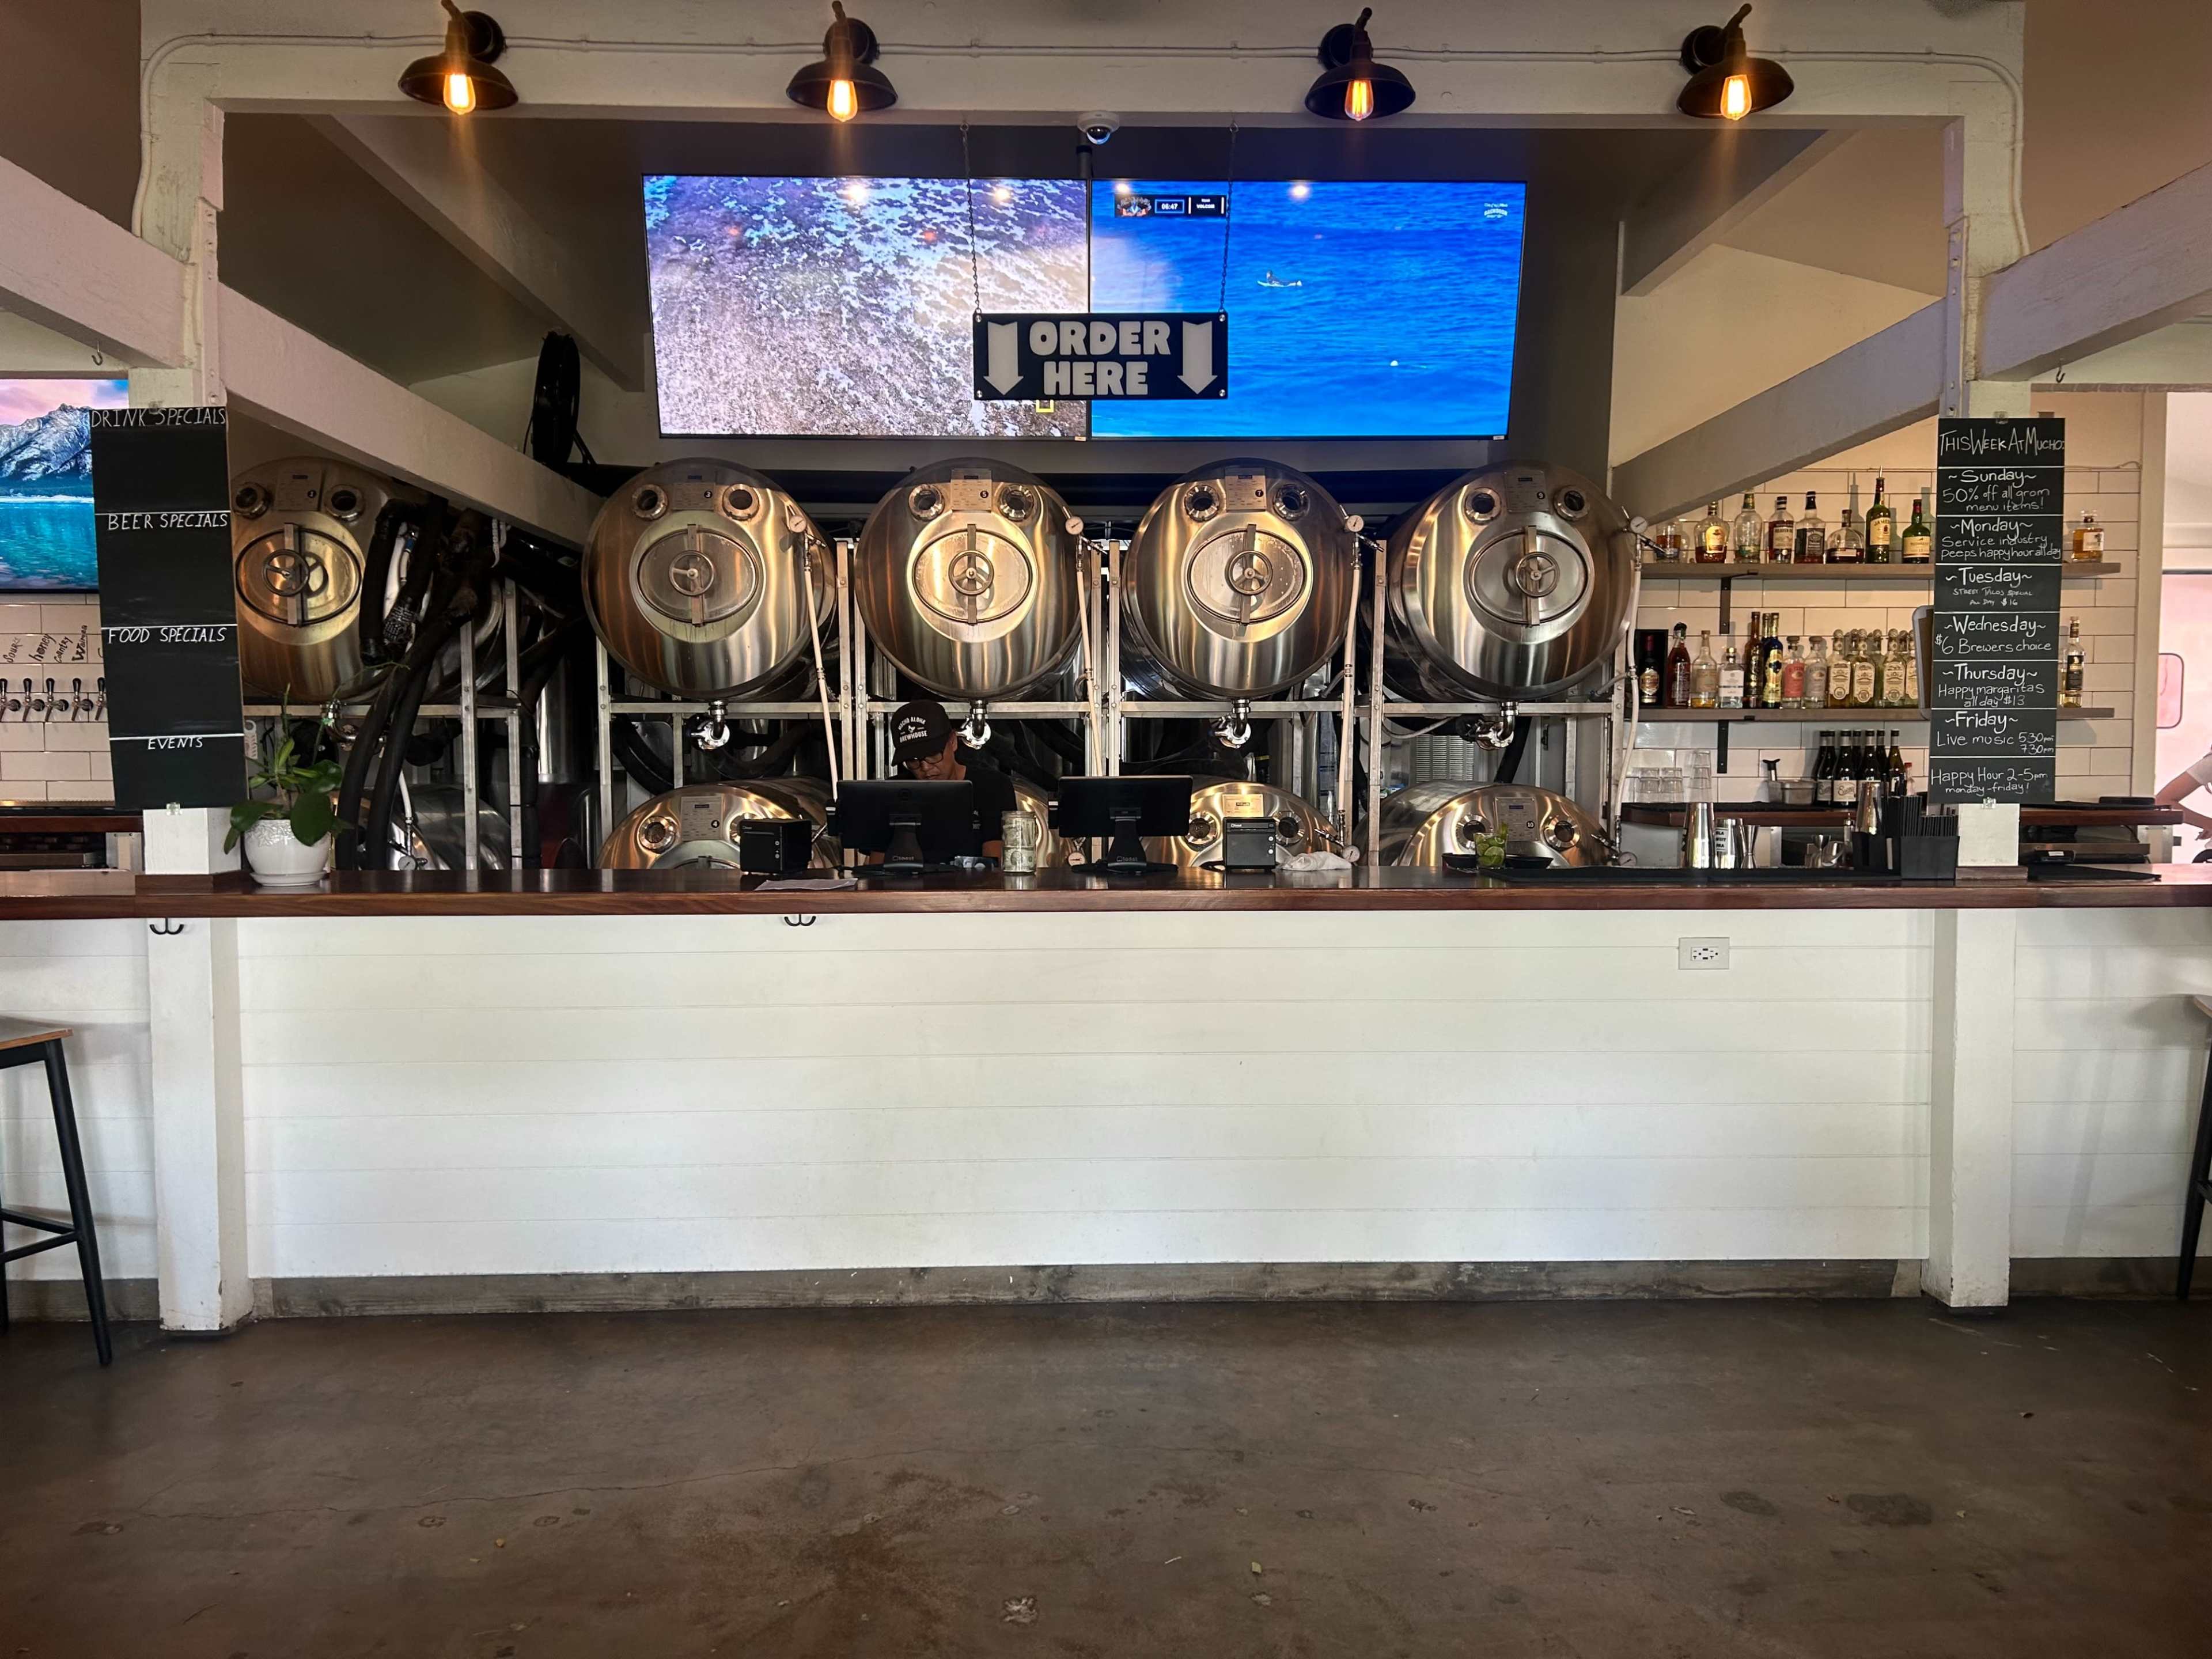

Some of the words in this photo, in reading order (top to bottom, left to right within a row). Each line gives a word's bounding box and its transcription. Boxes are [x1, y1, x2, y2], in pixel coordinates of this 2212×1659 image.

[1029, 320, 1171, 356] ORDER
[1043, 361, 1149, 396] HERE
[91, 408, 147, 427] DRINK
[156, 407, 226, 425] SPECIALS
[1940, 430, 1971, 456] THIS
[1970, 428, 2007, 455] WEEK
[2008, 427, 2024, 454] AT
[1943, 486, 1978, 503] 50%
[1983, 484, 1999, 501] off
[2002, 486, 2012, 499] all
[1966, 503, 1999, 512] menu
[2003, 497, 2044, 511] items!
[108, 513, 153, 530] BEER
[160, 513, 228, 528] SPECIALS
[1942, 536, 1995, 548] Service
[1999, 532, 2048, 547] industry
[1941, 549, 1978, 561] peeps
[1979, 548, 2011, 562] happy
[2011, 547, 2034, 557] hour
[2047, 543, 2061, 559] day
[108, 628, 150, 644] FOOD
[160, 627, 228, 643] SPECIALS
[1934, 634, 1955, 655] $6
[1958, 638, 2014, 654] Brewers
[2016, 639, 2052, 651] choice
[1938, 684, 1975, 701] Happy
[1976, 682, 2045, 700] margaritas
[1964, 696, 1978, 708] all
[1979, 697, 1998, 708] day
[2003, 695, 2025, 706] $13
[147, 737, 203, 750] EVENTS
[1937, 731, 1968, 747] Live
[1972, 735, 2014, 745] music
[1930, 768, 1974, 787] Happy
[1978, 767, 2005, 781] Hour
[2006, 768, 2048, 782] 2-5pm
[1945, 783, 1985, 796] monday
